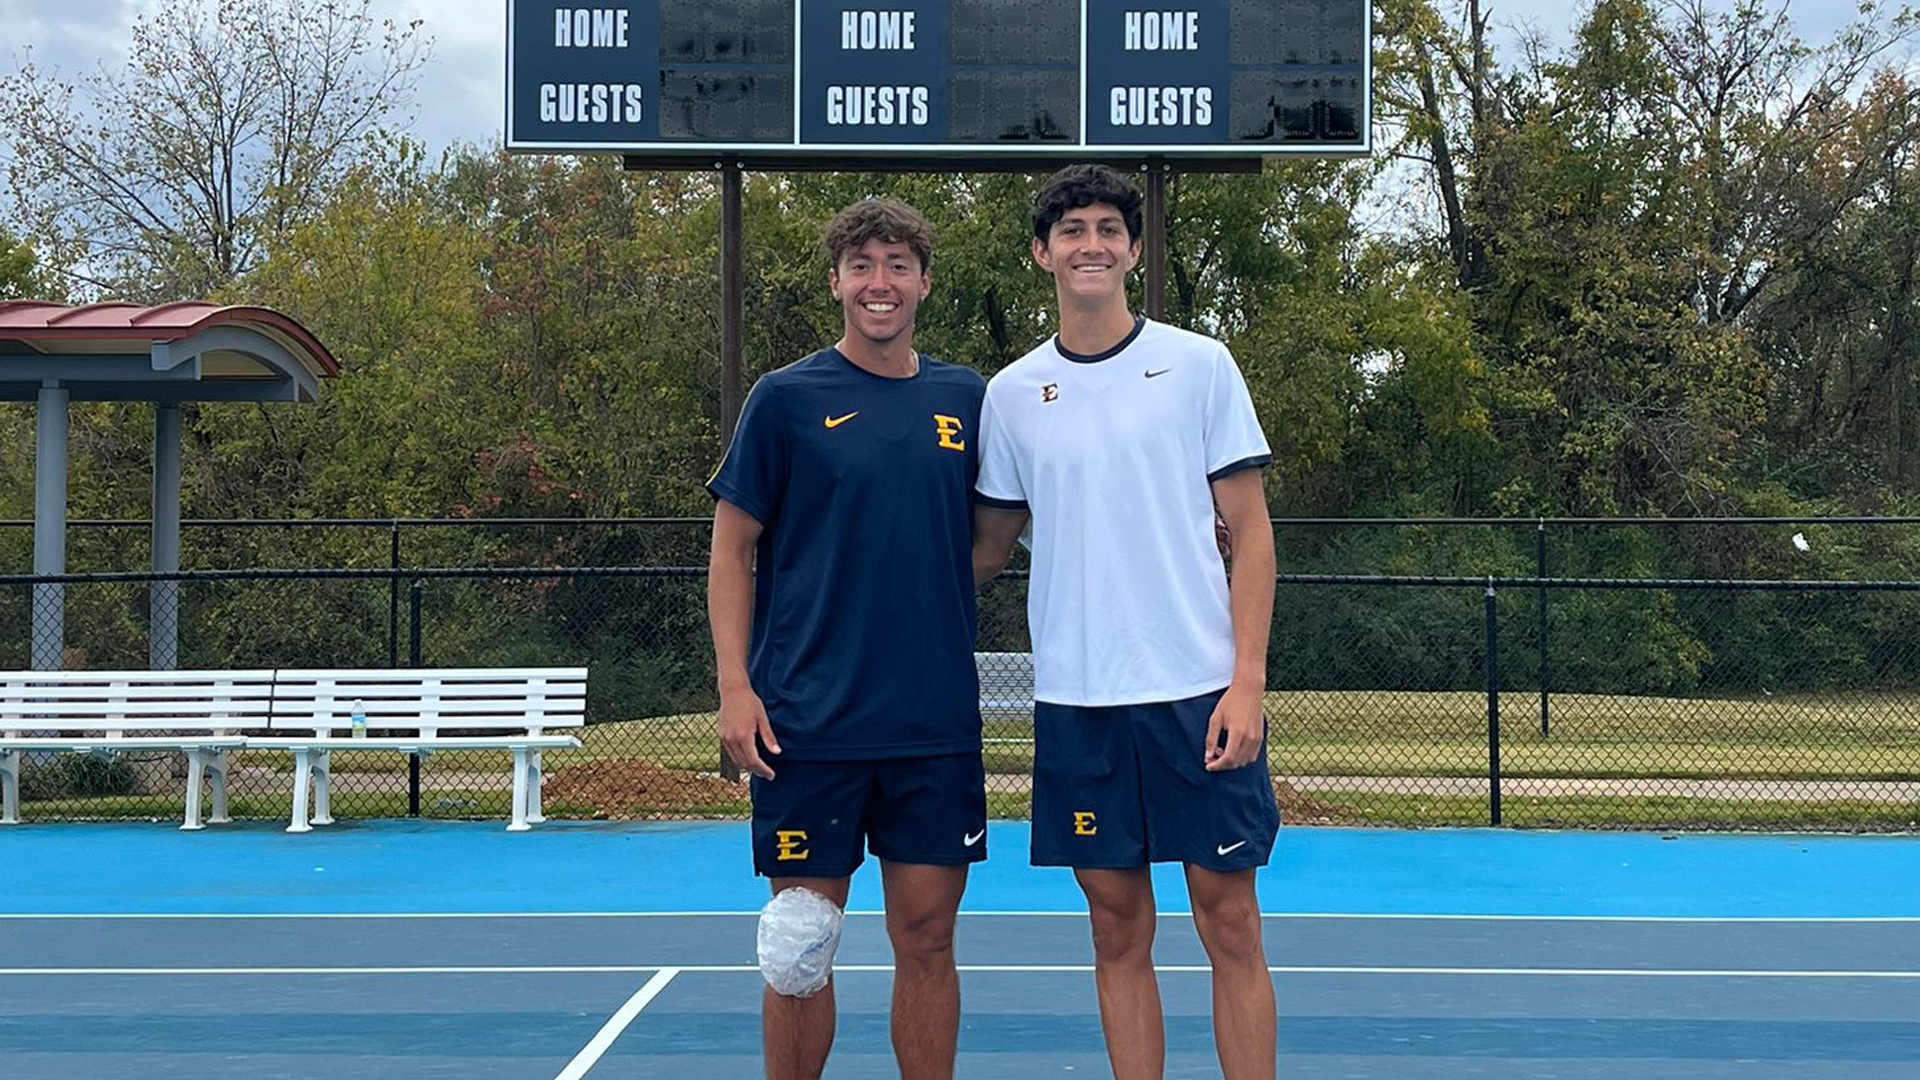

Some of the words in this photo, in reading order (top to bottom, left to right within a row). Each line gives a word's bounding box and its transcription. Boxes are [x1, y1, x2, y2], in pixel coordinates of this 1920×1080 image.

[555, 9, 628, 48] HOME
[842, 11, 915, 50] HOME
[1125, 11, 1198, 50] HOME
[540, 83, 642, 123] GUESTS
[827, 86, 928, 125] GUESTS
[1110, 86, 1212, 126] GUESTS
[1042, 383, 1058, 403] E
[933, 414, 966, 452] E
[1073, 811, 1097, 836] E
[776, 830, 809, 861] E
